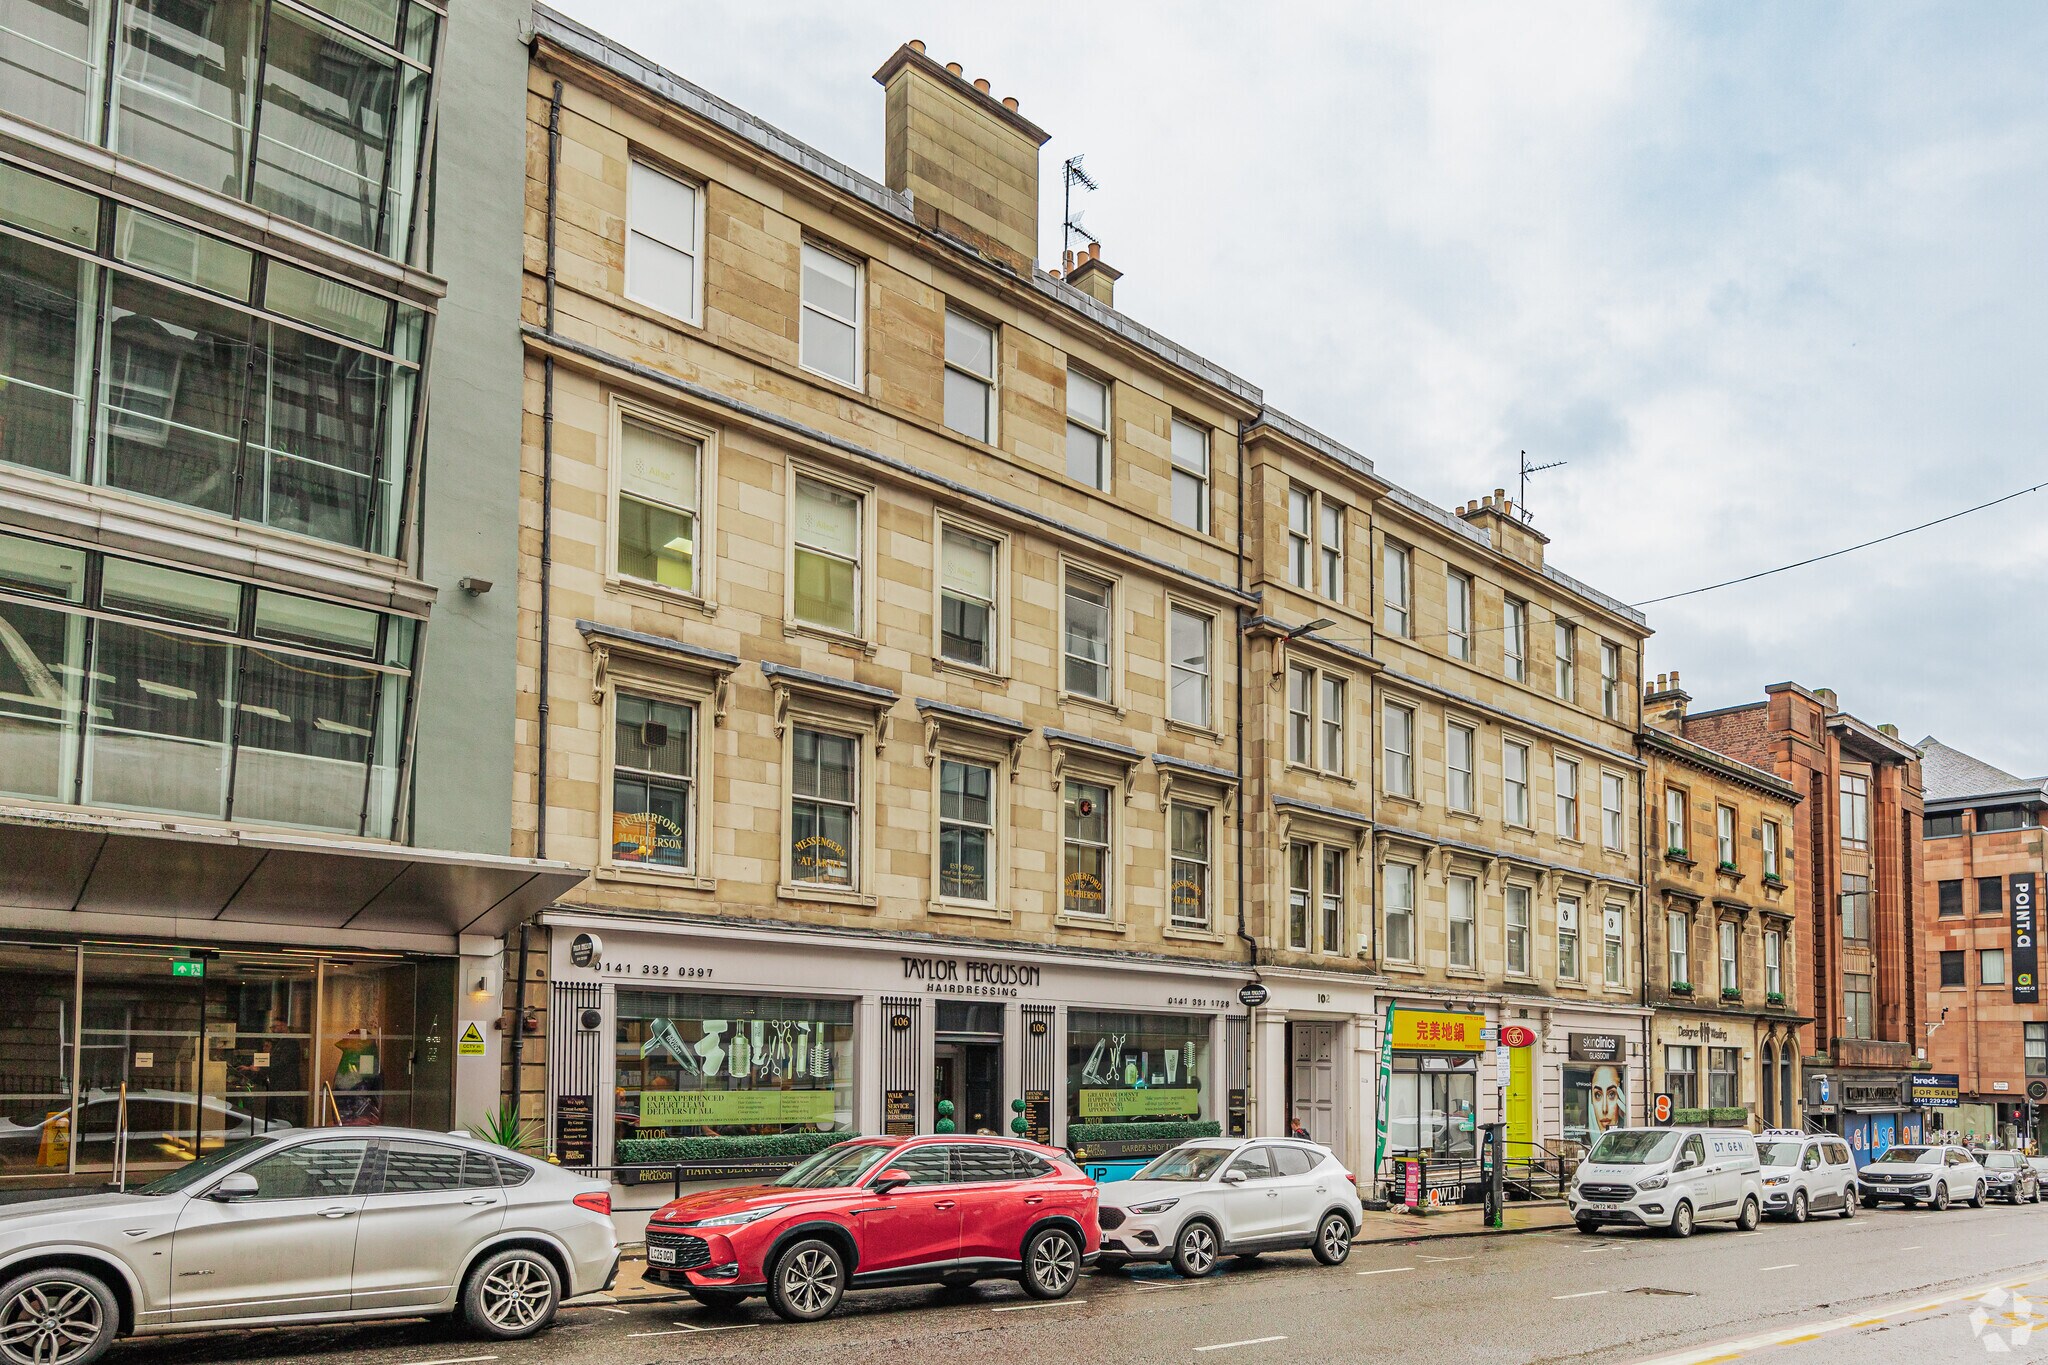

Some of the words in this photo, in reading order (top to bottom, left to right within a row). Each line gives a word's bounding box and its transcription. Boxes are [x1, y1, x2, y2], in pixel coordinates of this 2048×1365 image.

[619, 812, 683, 837] RUTHERFORD
[619, 832, 684, 850] MACPHERSON
[795, 836, 847, 857] MESSENGERS
[594, 961, 631, 973] 0141
[643, 964, 669, 975] 332
[679, 966, 713, 977] 0397
[901, 957, 958, 981] TAYLOR
[966, 961, 1040, 986] FERGUSON
[927, 983, 1018, 997] HAIRDRESSING
[1168, 997, 1188, 1006] 0141
[1211, 999, 1230, 1008] 1728
[894, 1017, 909, 1027] 106
[1033, 1023, 1045, 1033] 106
[1416, 1020, 1465, 1042] 完美地鍋
[1678, 1025, 1700, 1040] Designer
[1583, 1036, 1616, 1049] skinclinics
[1589, 1052, 1610, 1060] GLASGOW
[1913, 1076, 1938, 1085] breck
[647, 1101, 679, 1109] EXPERT
[680, 1101, 705, 1109] TEAM
[636, 1129, 667, 1139] TAYLOR
[1122, 1144, 1146, 1153] BARBER
[1147, 1143, 1165, 1152] SHOP
[1714, 1142, 1725, 1152] DT
[1727, 1141, 1744, 1152] GEN
[639, 1171, 673, 1181] FERGUSON
